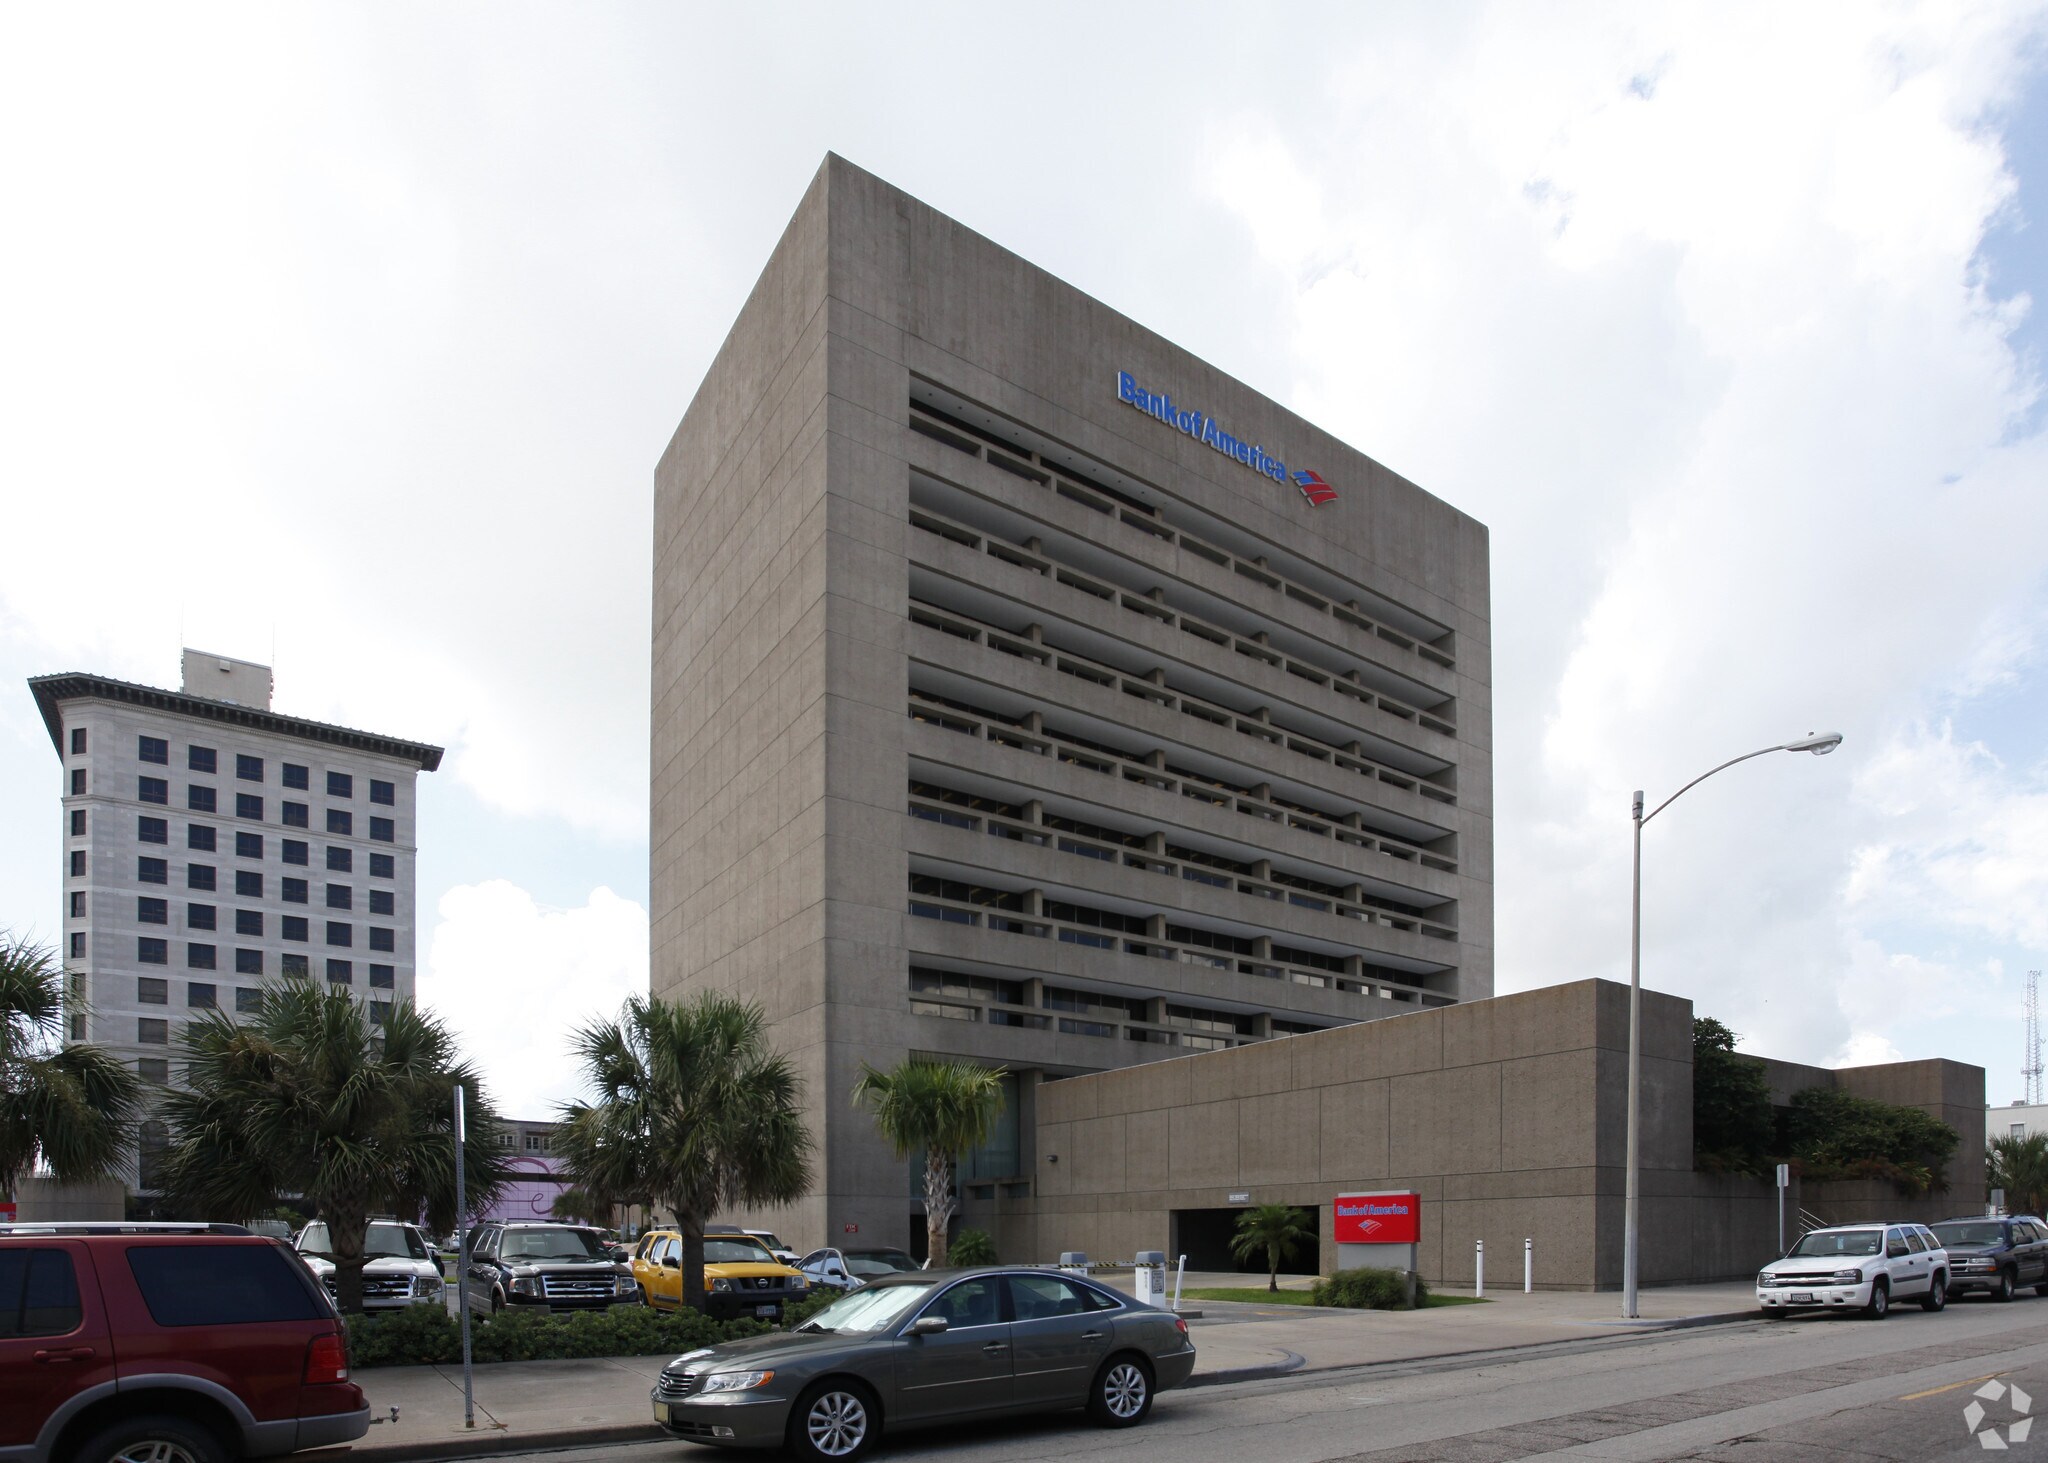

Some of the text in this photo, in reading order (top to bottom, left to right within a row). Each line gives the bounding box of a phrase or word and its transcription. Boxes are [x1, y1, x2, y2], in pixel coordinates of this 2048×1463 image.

[1118, 371, 1287, 484] Bank of America
[1337, 1204, 1408, 1216] Bank of America
